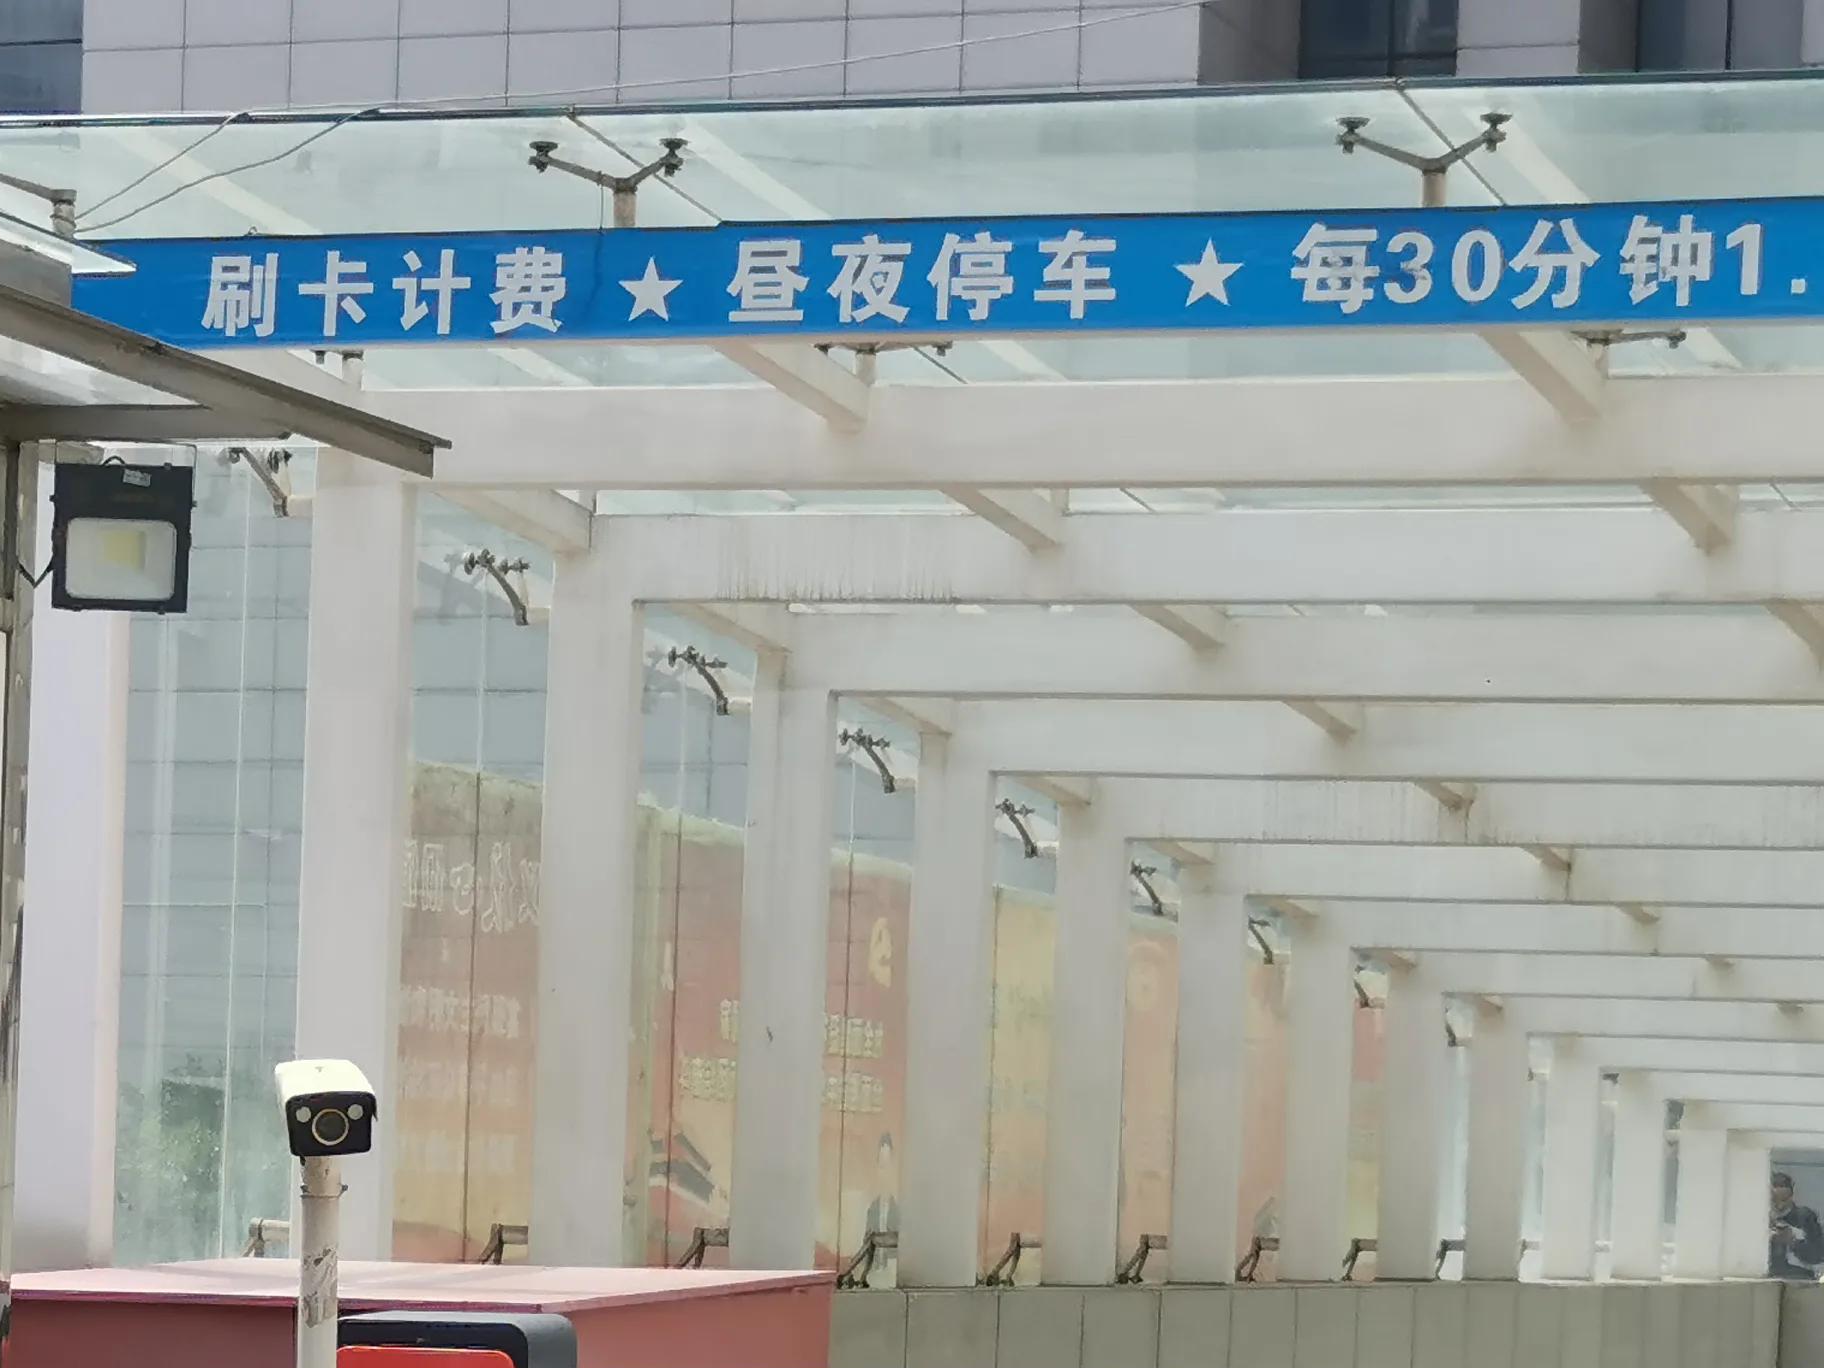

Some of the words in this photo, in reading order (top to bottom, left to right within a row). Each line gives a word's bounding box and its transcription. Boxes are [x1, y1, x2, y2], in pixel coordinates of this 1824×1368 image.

[201, 246, 567, 338] 刷卡计费
[726, 230, 1117, 324] 昼夜停车
[1290, 214, 1807, 314] 每30分钟1.
